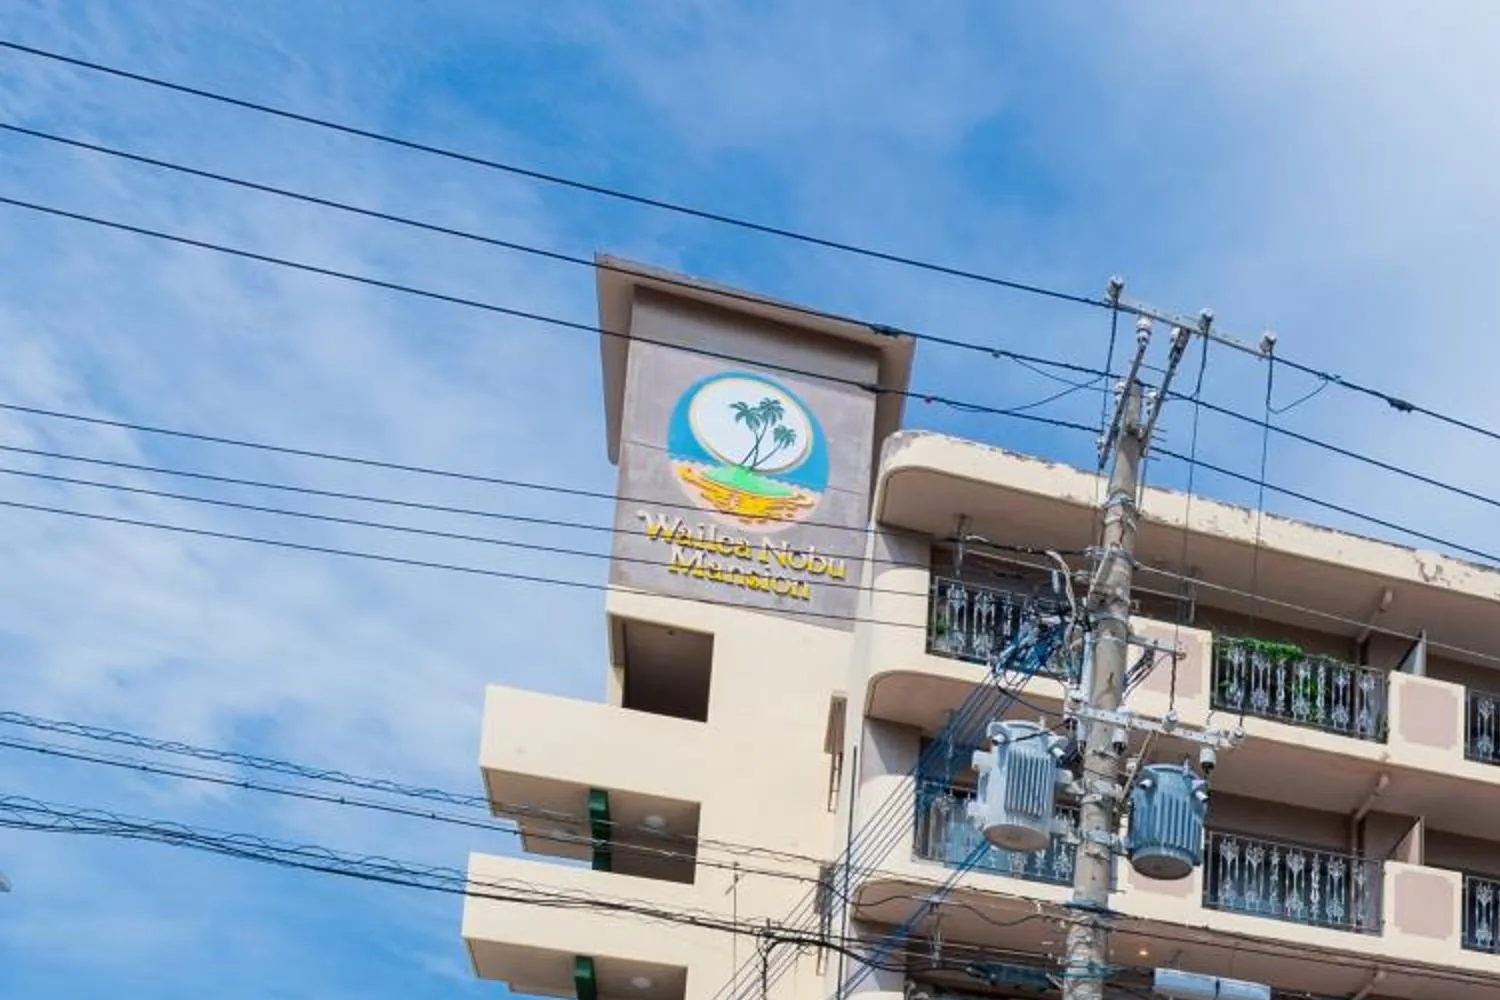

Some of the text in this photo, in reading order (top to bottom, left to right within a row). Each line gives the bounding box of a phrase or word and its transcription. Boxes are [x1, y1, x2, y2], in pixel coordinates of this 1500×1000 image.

[636, 509, 847, 581] Wailea Nobu
[668, 545, 811, 601] Mansion
